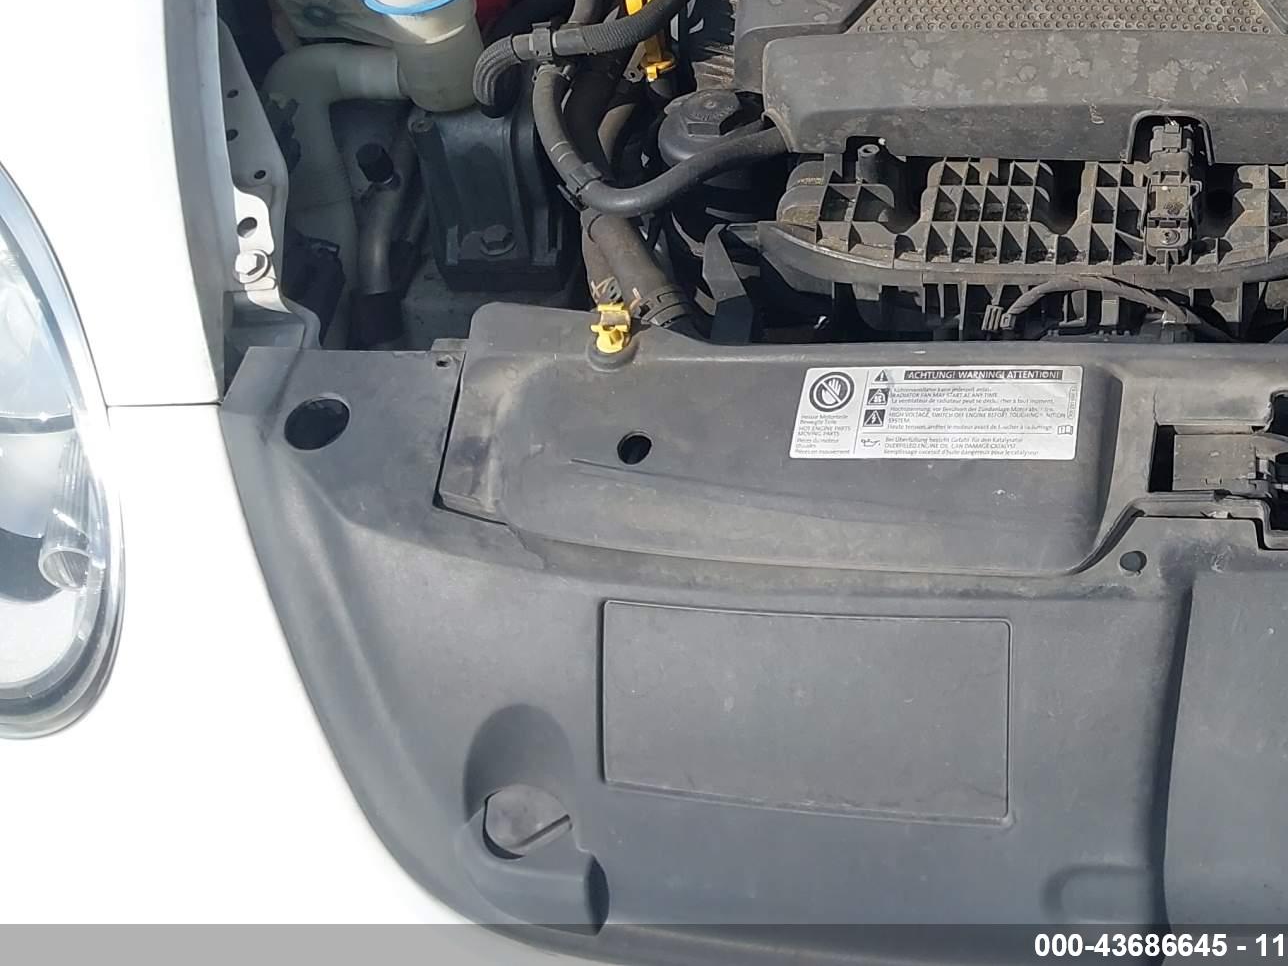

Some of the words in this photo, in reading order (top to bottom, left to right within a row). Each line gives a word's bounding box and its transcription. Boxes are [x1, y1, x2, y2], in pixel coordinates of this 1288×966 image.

[908, 371, 956, 379] ACHTUNG!
[958, 370, 1006, 379] WARNING!
[1007, 370, 1060, 379] ATTENTION!
